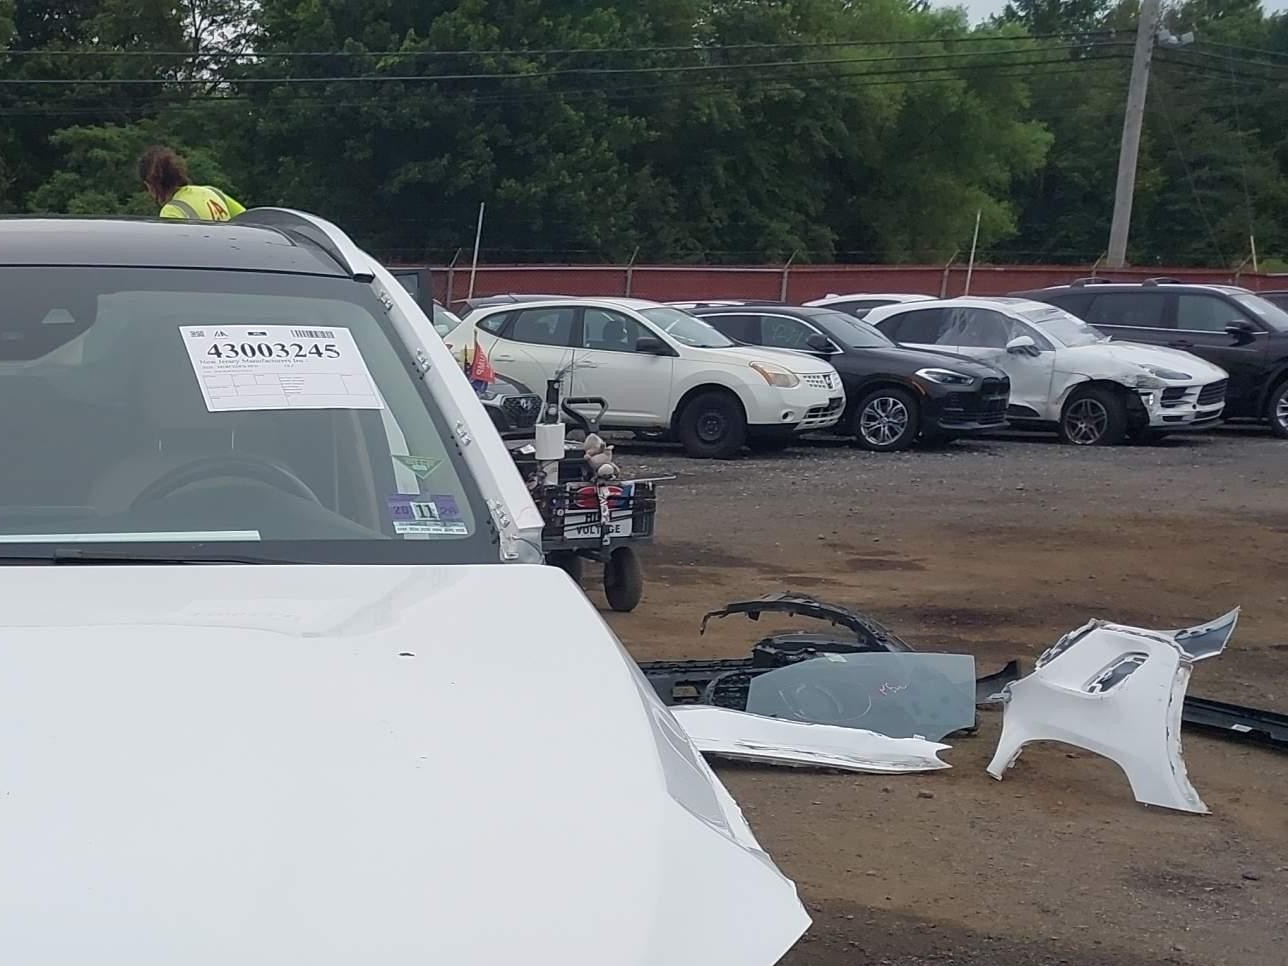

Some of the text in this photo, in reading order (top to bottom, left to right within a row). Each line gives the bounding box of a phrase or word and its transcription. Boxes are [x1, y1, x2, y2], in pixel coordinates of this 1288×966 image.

[207, 343, 341, 359] 43003245
[415, 504, 437, 518] 11
[576, 524, 621, 535] VOLTGE
